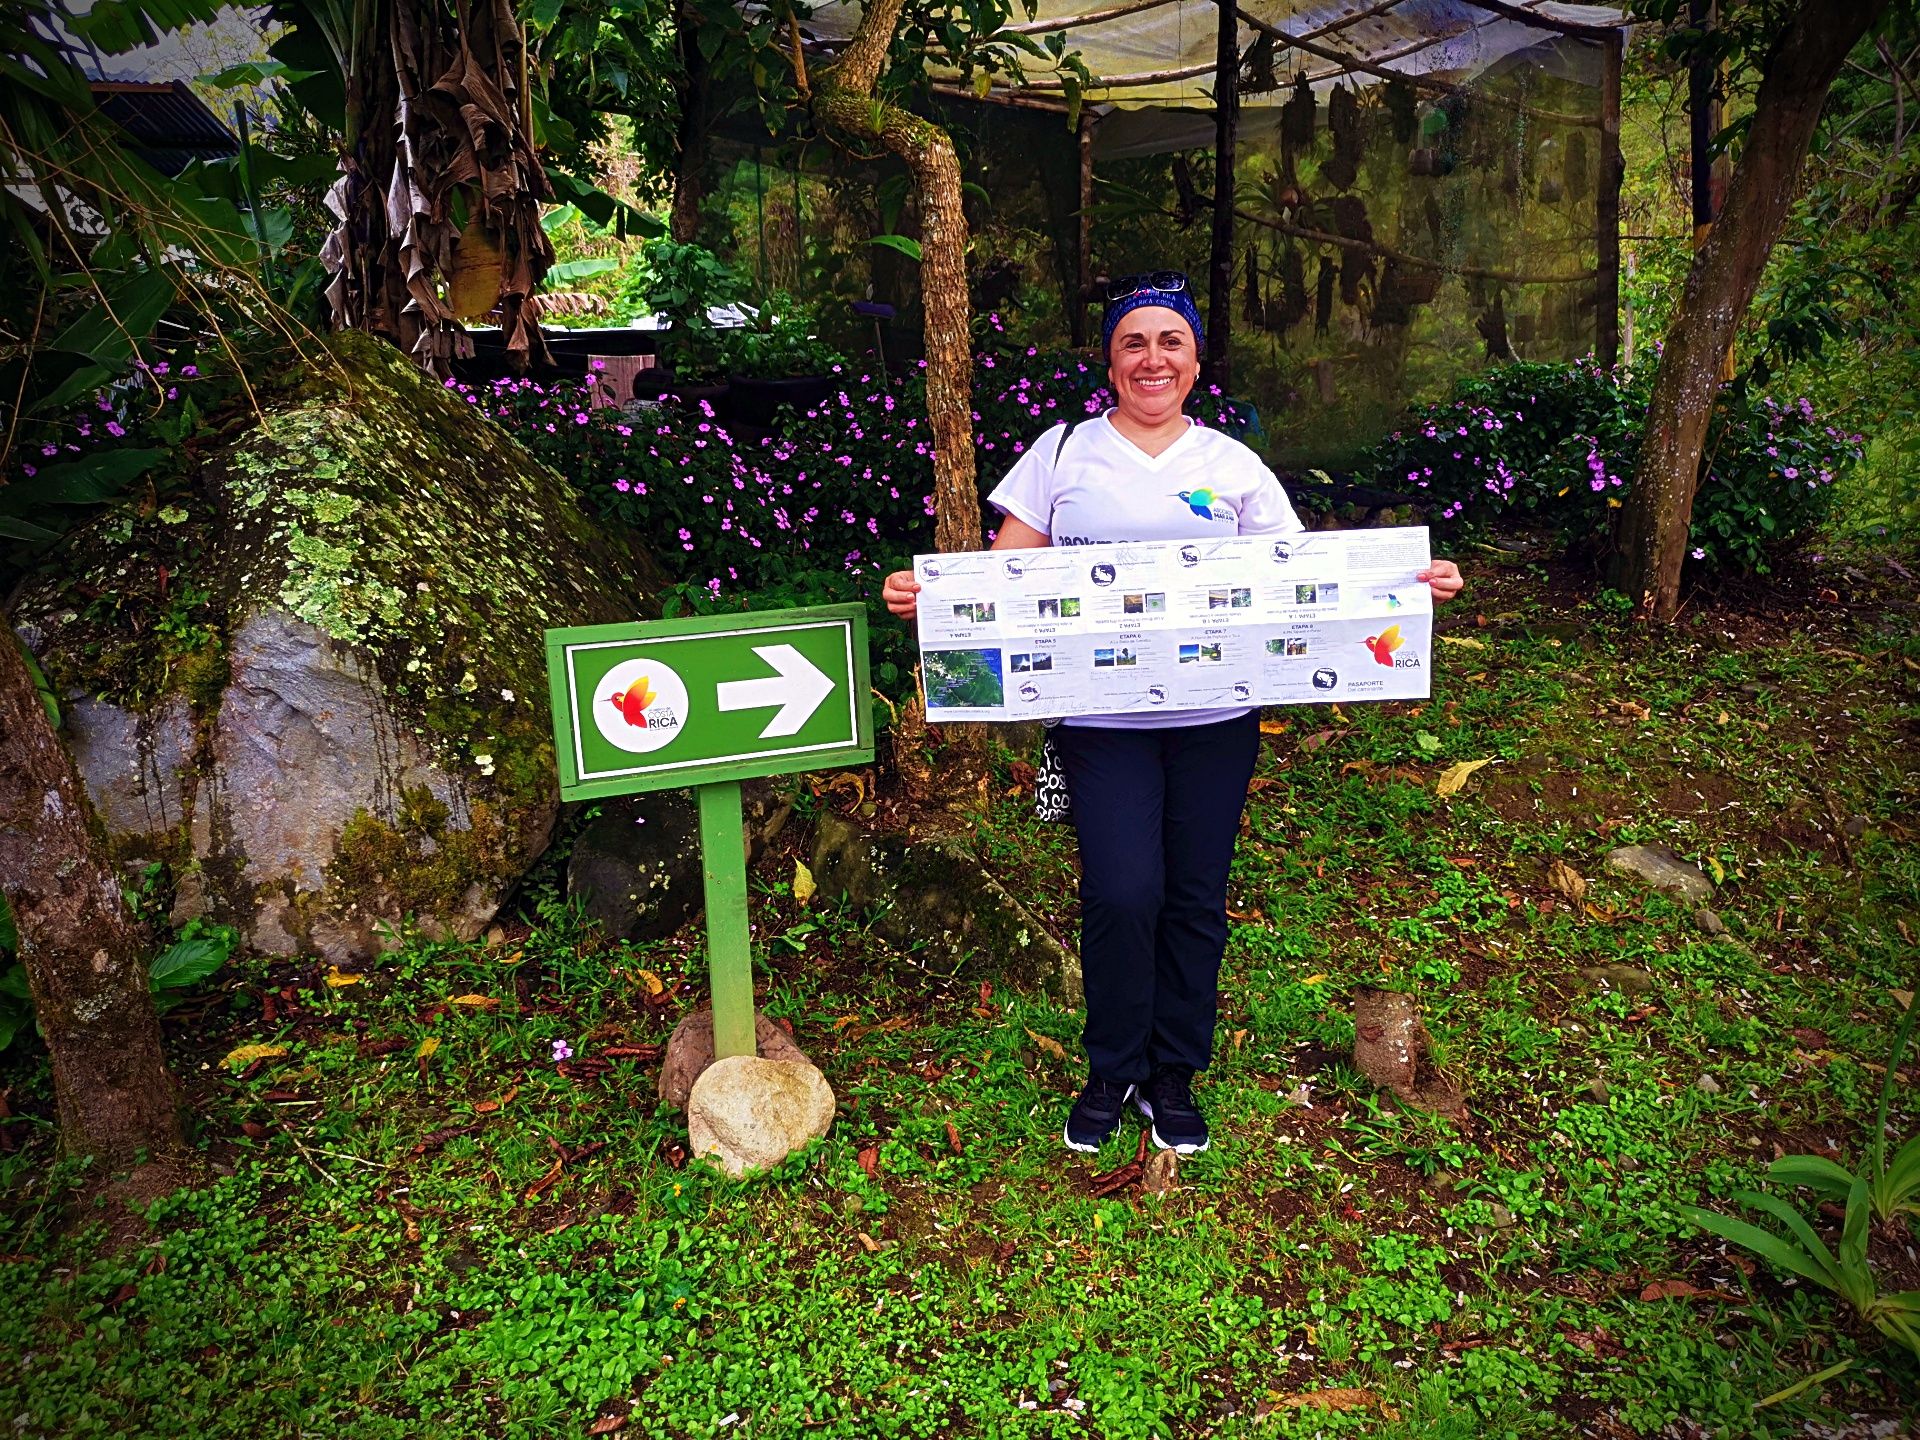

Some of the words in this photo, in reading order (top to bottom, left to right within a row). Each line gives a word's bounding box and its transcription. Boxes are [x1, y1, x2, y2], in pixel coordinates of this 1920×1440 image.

[1395, 658, 1421, 668] RICA
[648, 710, 675, 719] COSTA
[649, 717, 679, 729] RICA
